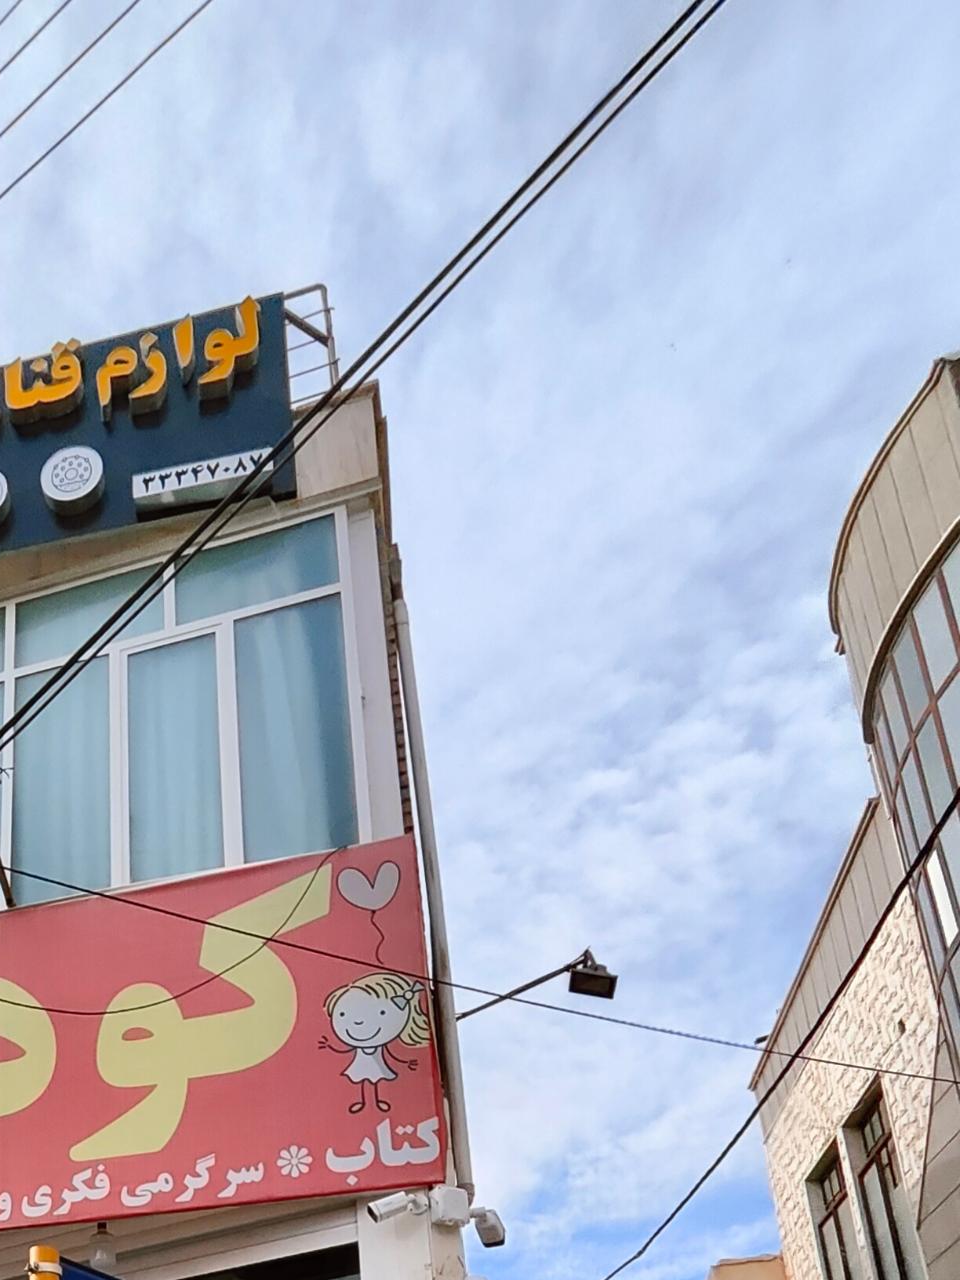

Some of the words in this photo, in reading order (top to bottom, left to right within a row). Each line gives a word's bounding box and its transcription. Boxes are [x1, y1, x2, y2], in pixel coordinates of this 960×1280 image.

[97, 295, 261, 412] لوازم
[121, 1154, 265, 1207] سرگرمی
[325, 1117, 441, 1185] کتاب
[21, 1164, 111, 1217] فکری
